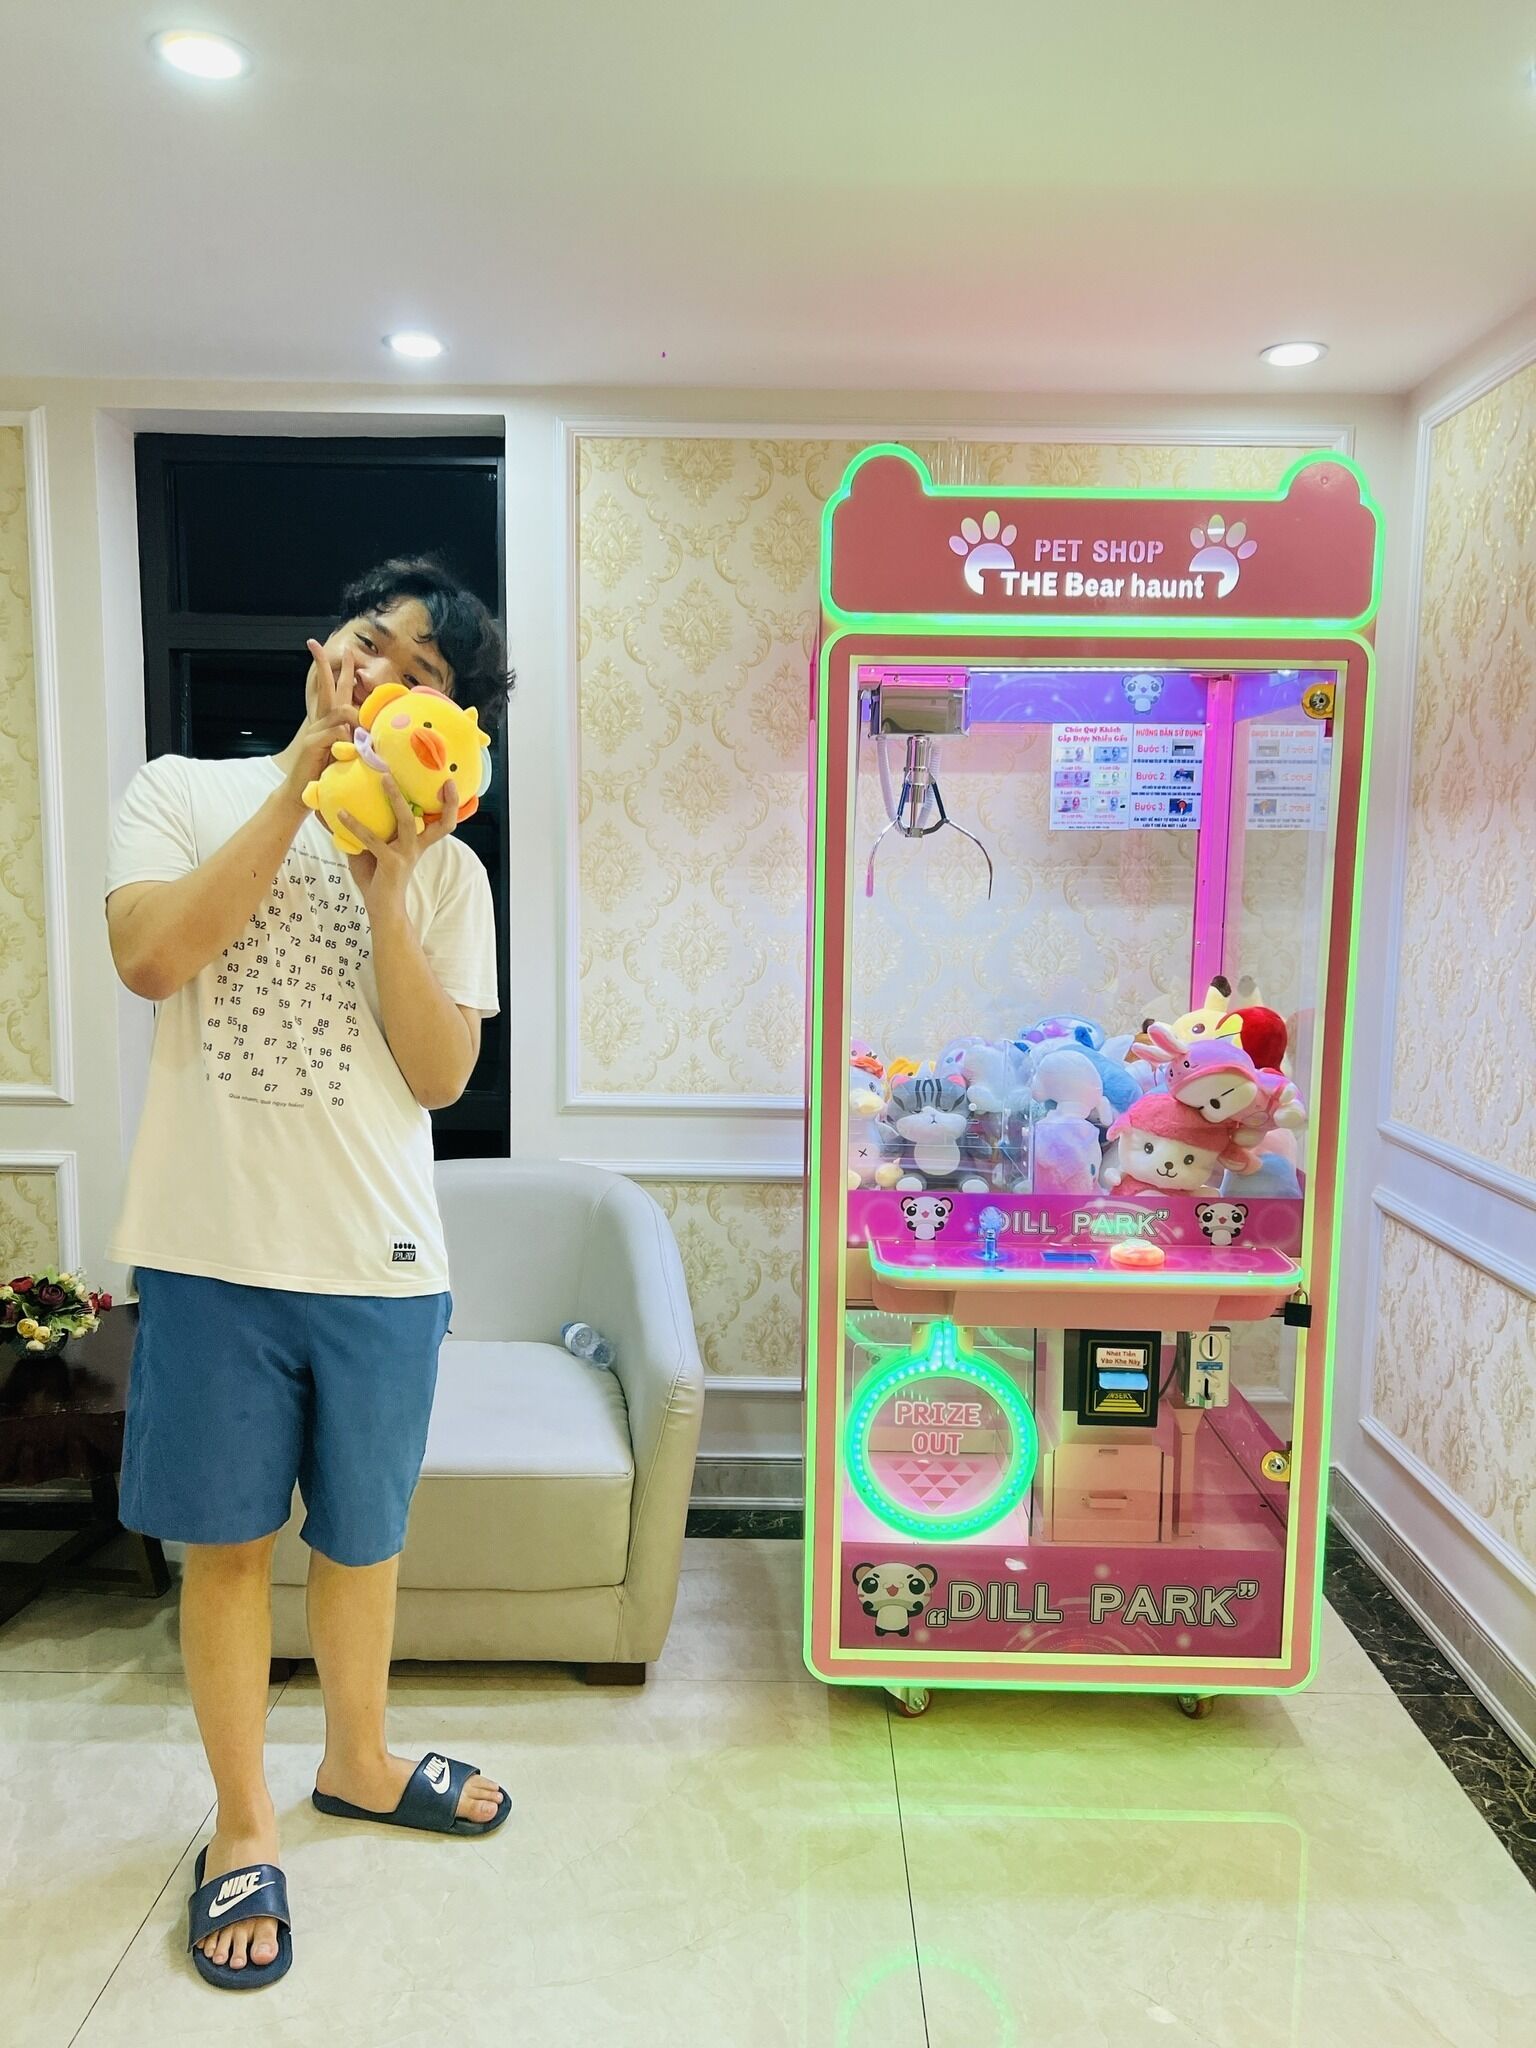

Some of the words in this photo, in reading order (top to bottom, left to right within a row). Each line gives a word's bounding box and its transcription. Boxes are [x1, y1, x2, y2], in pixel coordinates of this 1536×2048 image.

[1035, 539, 1083, 562] PET
[1092, 540, 1165, 563] SHOP
[1000, 571, 1058, 597] THE
[1064, 572, 1124, 598] Bear
[1131, 573, 1205, 599] haunt
[1137, 744, 1160, 753] Bước
[1134, 802, 1156, 811] Bước
[290, 875, 300, 885] 54
[304, 876, 316, 885] 97
[328, 874, 341, 884] 83
[272, 888, 284, 900] 93
[338, 892, 350, 902] 91
[318, 899, 328, 910] 75
[334, 904, 348, 914] 47
[268, 906, 281, 916] 82
[355, 905, 366, 915] 10
[290, 912, 302, 922] 49
[255, 920, 266, 930] 92
[280, 922, 290, 932] 76
[333, 922, 346, 933] 80
[347, 920, 360, 931] 38
[247, 938, 258, 947] 21
[290, 936, 301, 946] 72
[309, 934, 321, 944] 34
[325, 939, 336, 949] 65
[345, 938, 358, 948] 99
[232, 941, 245, 950] 43
[275, 947, 286, 957] 19
[358, 948, 370, 958] 12
[256, 954, 268, 964] 89
[304, 954, 316, 964] 61
[338, 956, 348, 966] 98
[227, 962, 240, 973] 63
[289, 964, 302, 975] 31
[320, 965, 333, 976] 56
[246, 968, 259, 978] 22
[217, 975, 228, 984] 28
[272, 978, 282, 986] 44
[286, 977, 300, 987] 57
[232, 983, 244, 992] 37
[256, 986, 268, 996] 15
[304, 982, 316, 992] 25
[214, 996, 224, 1006] 11
[230, 996, 240, 1005] 45
[321, 992, 332, 1002] 14
[278, 999, 290, 1008] 59
[300, 999, 311, 1008] 71
[252, 1007, 265, 1016] 69
[208, 1018, 220, 1028] 68
[227, 1016, 238, 1026] 55
[282, 1020, 292, 1030] 35
[318, 1018, 329, 1028] 88
[238, 1024, 248, 1033] 18
[312, 1026, 324, 1036] 95
[348, 1028, 359, 1036] 73
[234, 1036, 244, 1046] 79
[264, 1037, 277, 1046] 87
[286, 1040, 298, 1050] 32
[320, 1048, 332, 1056] 96
[340, 1043, 352, 1053] 86
[217, 1051, 231, 1060] 58
[242, 1052, 254, 1060] 81
[276, 1056, 288, 1064] 17
[310, 1060, 324, 1069] 30
[339, 1062, 350, 1072] 94
[218, 1072, 232, 1081] 40
[252, 1067, 264, 1077] 84
[296, 1068, 306, 1078] 78
[264, 1084, 278, 1092] 67
[328, 1081, 342, 1090] 52
[300, 1088, 313, 1096] 39
[331, 1096, 344, 1106] 90
[895, 1401, 982, 1427] PRIZE
[912, 1431, 964, 1455] OUT
[422, 1756, 446, 1782] NIKE
[216, 1871, 262, 1902] NIKE
